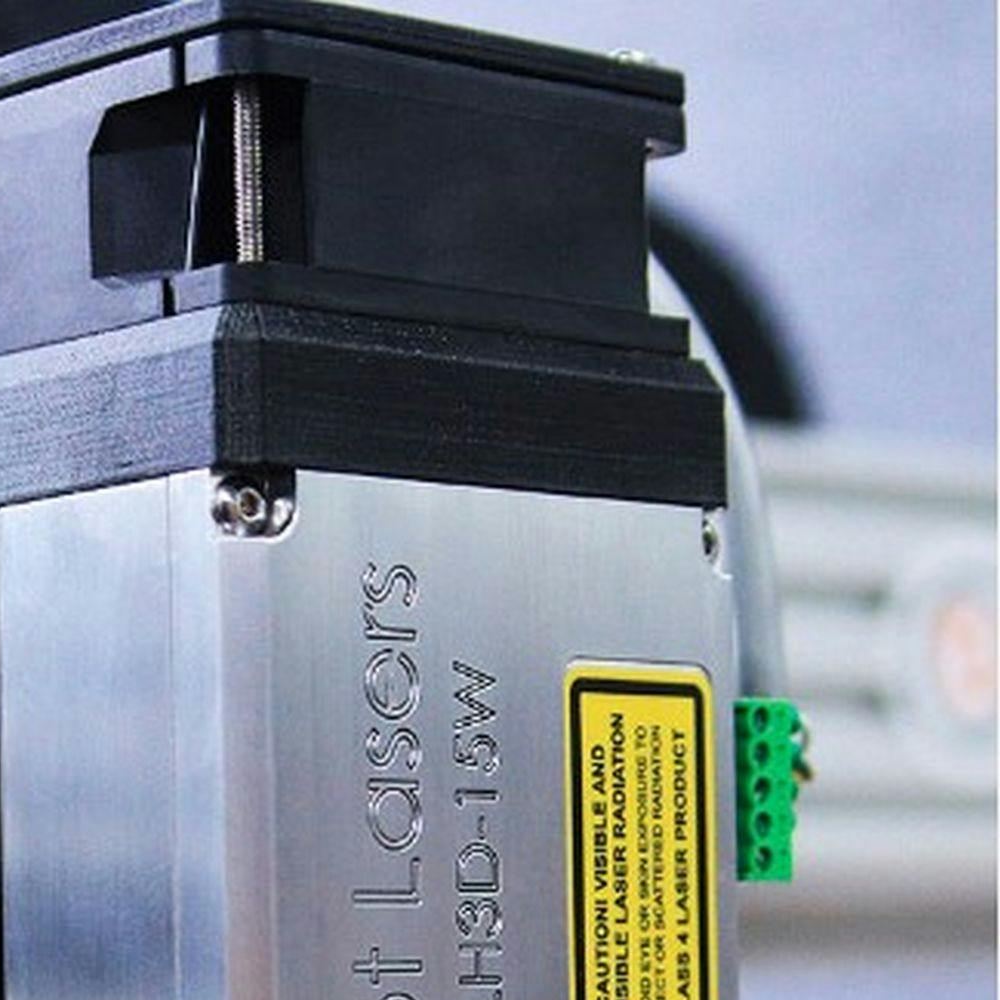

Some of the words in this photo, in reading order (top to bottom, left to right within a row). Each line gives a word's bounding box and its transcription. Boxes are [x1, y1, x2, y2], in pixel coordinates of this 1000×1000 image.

[352, 562, 423, 907] Lasers
[591, 744, 606, 794] AND
[634, 725, 647, 750] TO
[650, 725, 664, 820] RADIATION
[610, 713, 626, 838] RADIATION
[636, 756, 649, 852] EXPOSURE
[672, 729, 688, 841] PRODUCT
[592, 802, 608, 890] VISIBLE
[613, 845, 629, 924] LASER
[637, 858, 649, 899] SKIN
[652, 825, 666, 931] SCATTERED
[638, 906, 650, 931] OR
[674, 848, 690, 925] LASER
[639, 937, 650, 971] EYE
[654, 936, 666, 962] OR
[677, 932, 689, 945] 4
